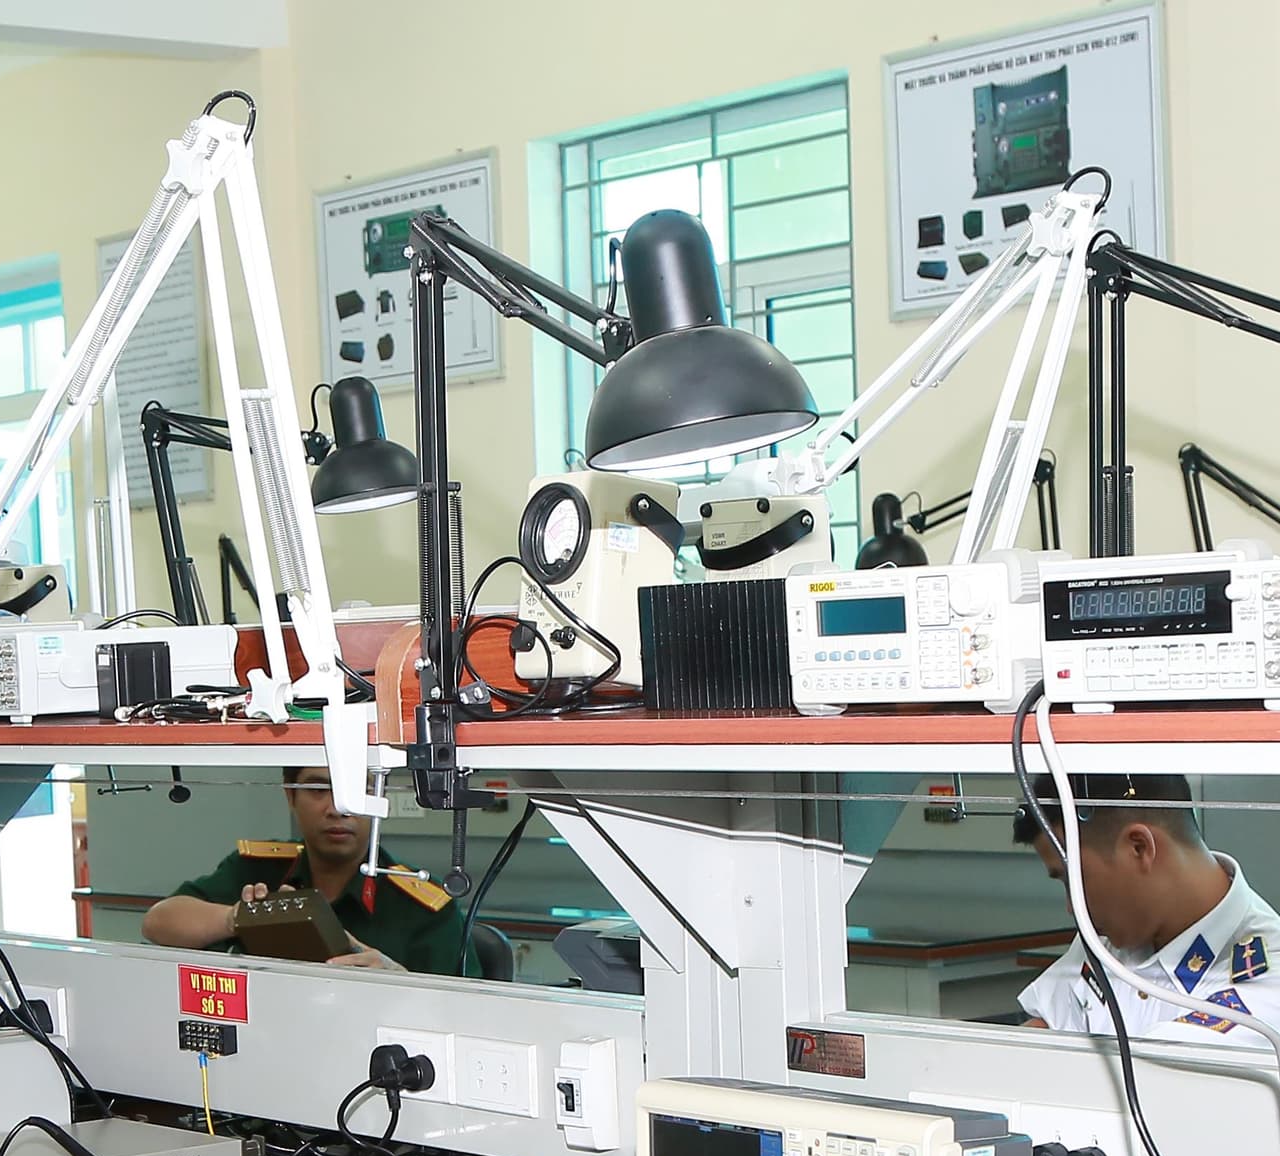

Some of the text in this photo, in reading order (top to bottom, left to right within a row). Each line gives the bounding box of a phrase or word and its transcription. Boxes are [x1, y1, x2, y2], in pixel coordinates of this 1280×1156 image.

[809, 582, 834, 592] RIGOL
[190, 973, 236, 994] VỊ TRÍ THI
[201, 994, 224, 1016] SỐ 5
